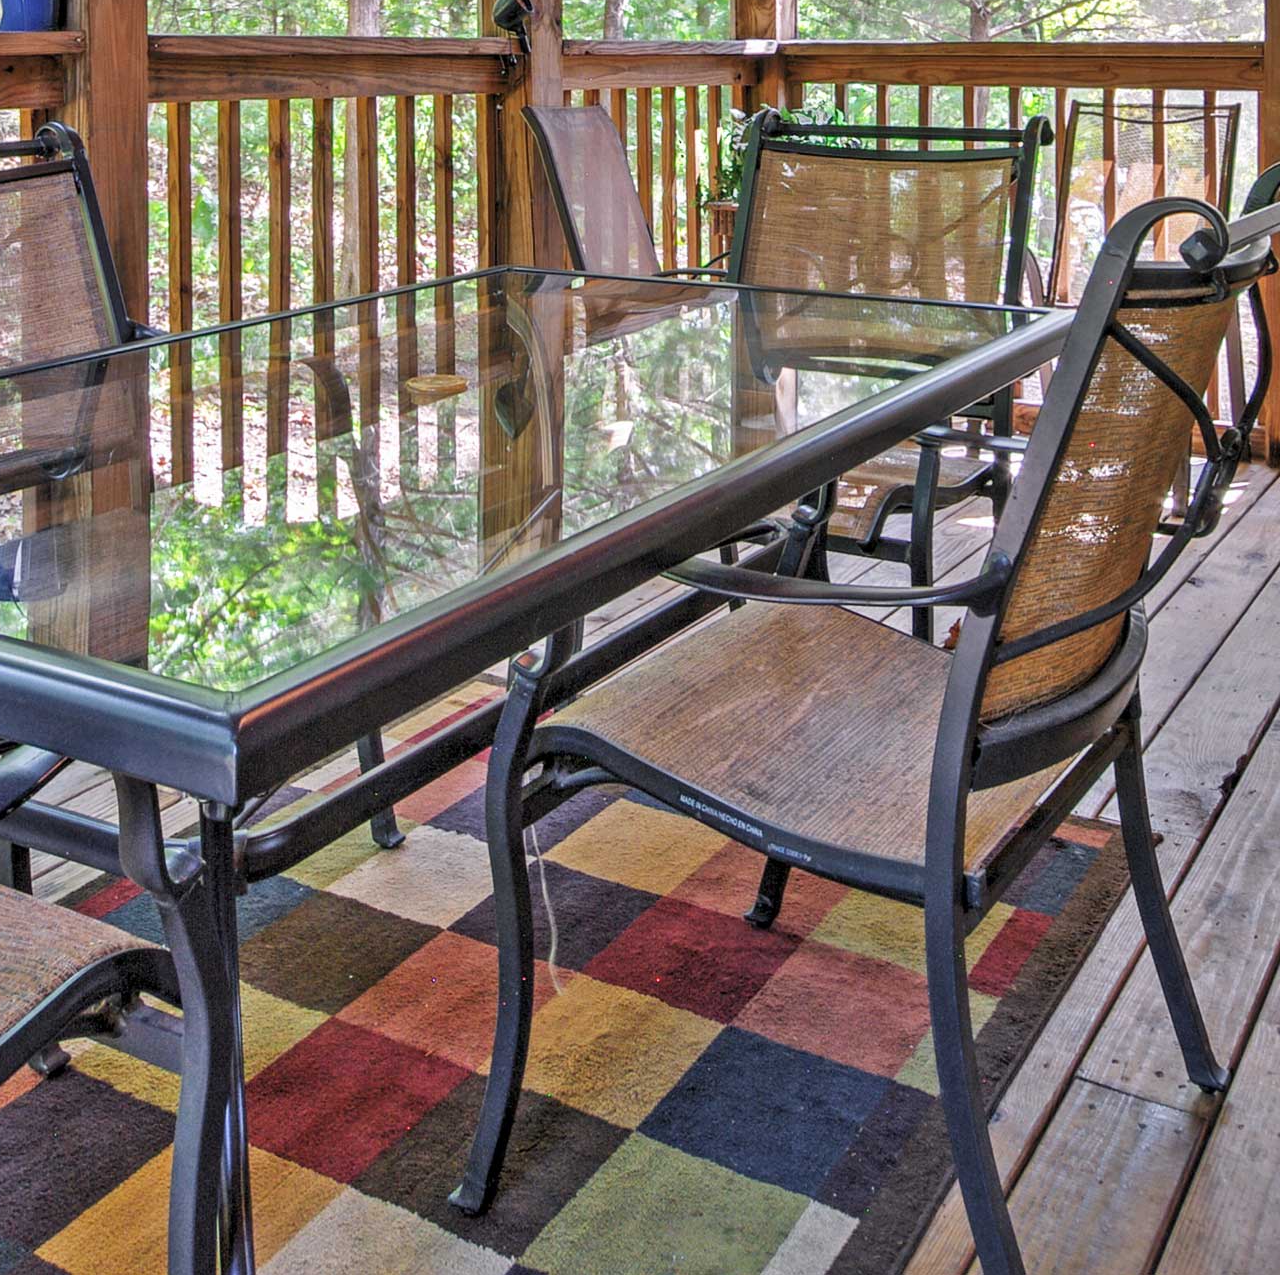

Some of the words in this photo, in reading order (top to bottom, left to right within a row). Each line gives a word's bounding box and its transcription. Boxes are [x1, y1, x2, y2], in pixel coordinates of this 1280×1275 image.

[680, 794, 695, 807] MADE
[702, 804, 718, 817] CHINA
[746, 824, 763, 838] CHINA
